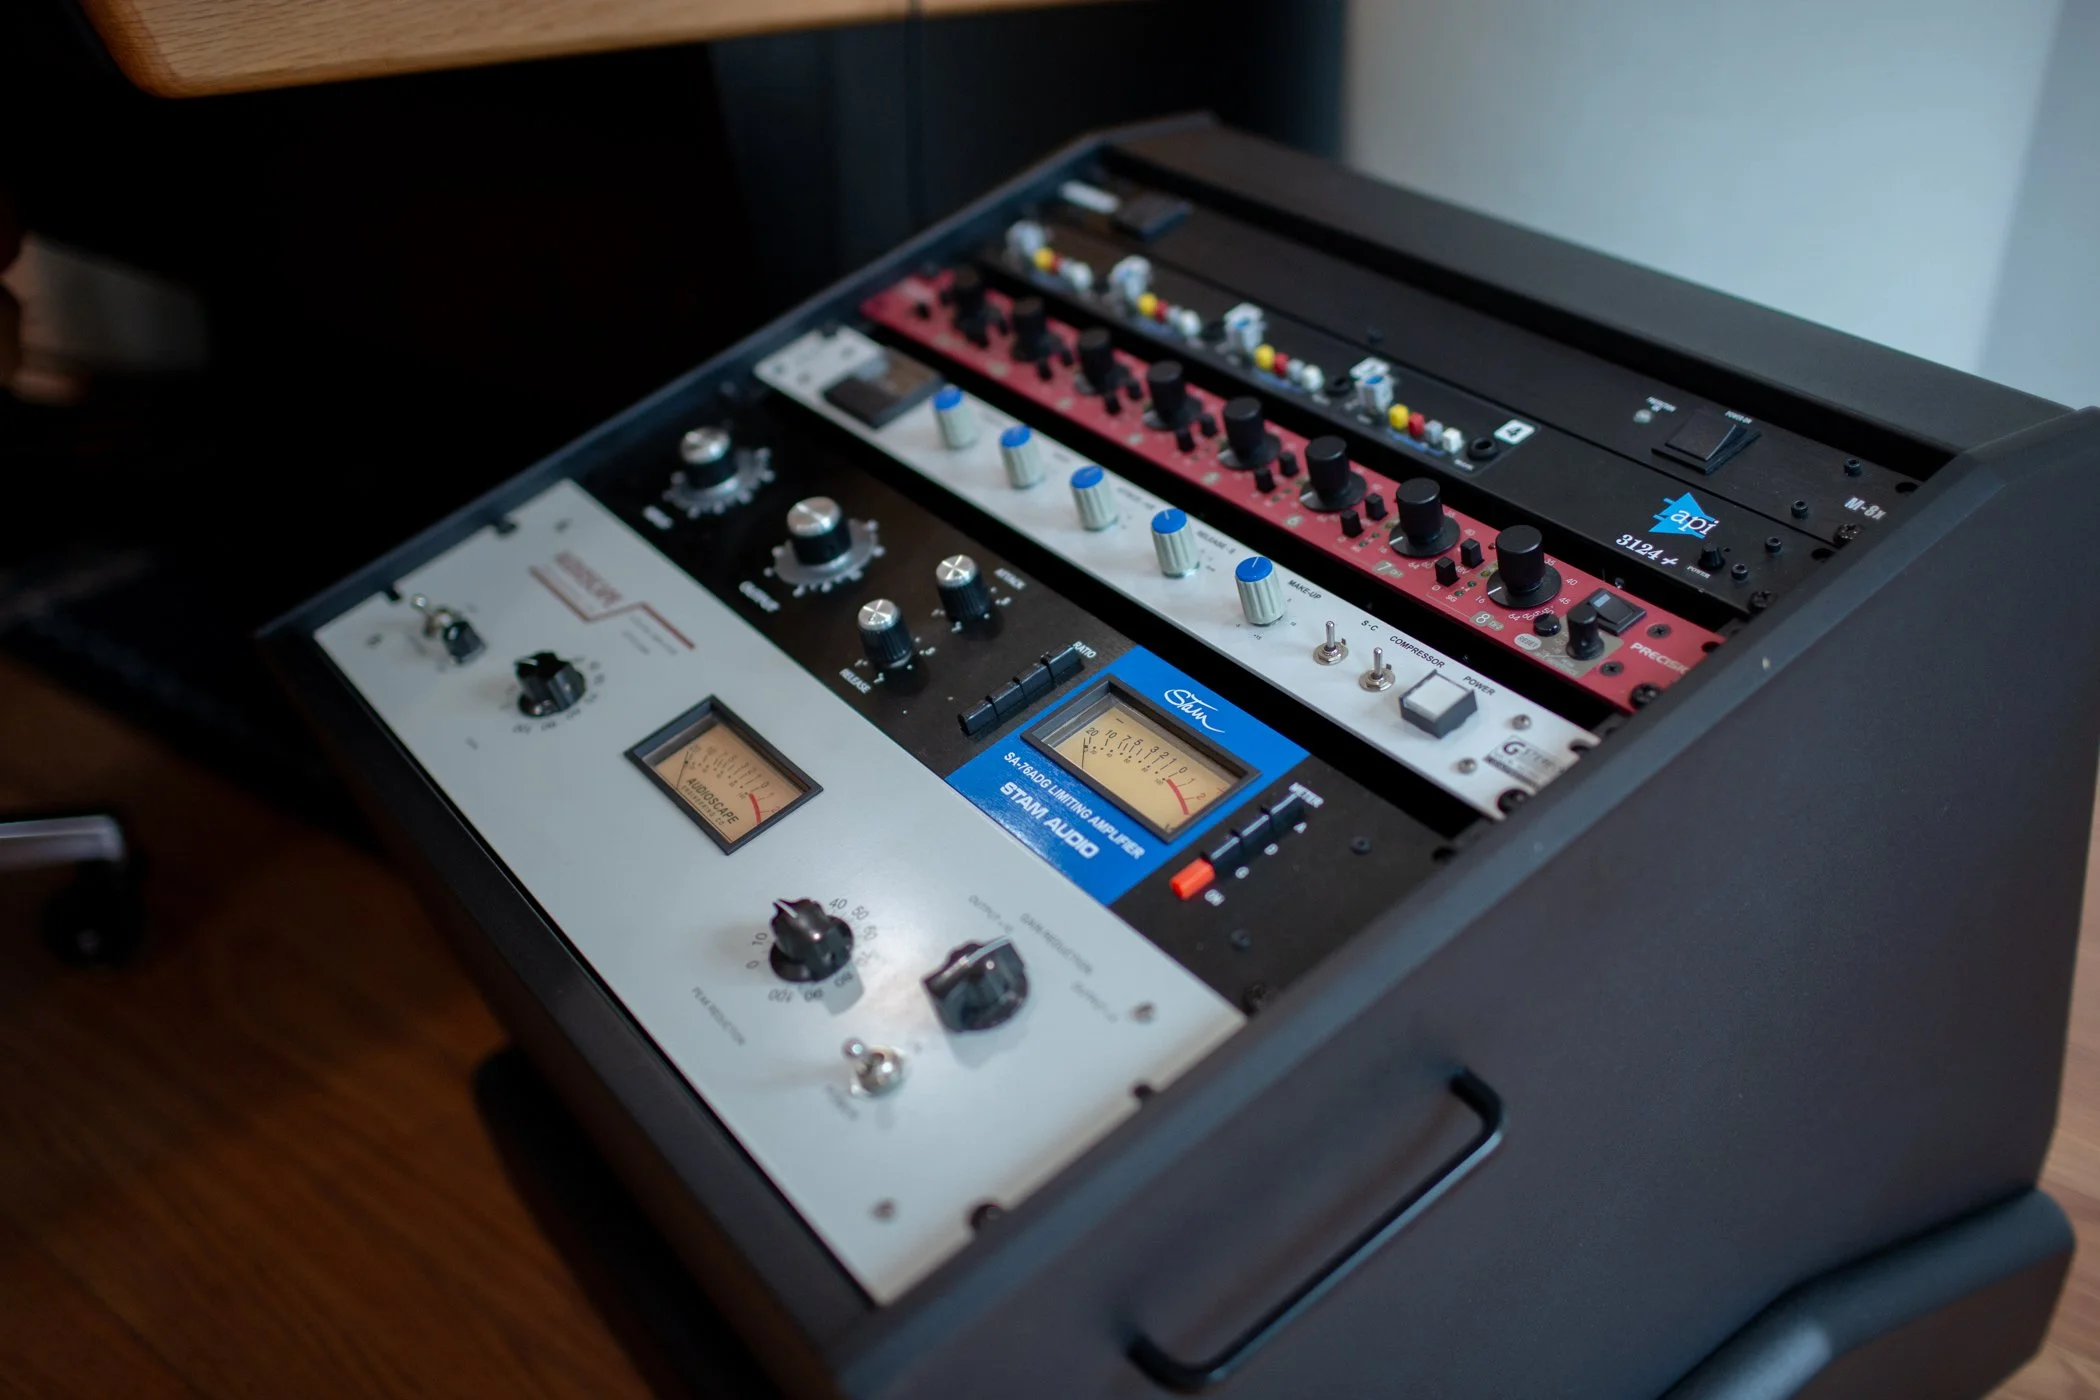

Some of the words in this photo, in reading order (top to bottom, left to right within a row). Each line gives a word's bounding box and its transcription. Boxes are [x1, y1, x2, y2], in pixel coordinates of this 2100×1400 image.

[1670, 510, 1720, 536] api
[1377, 562, 1392, 572] 7
[1686, 565, 1711, 579] POWER
[1287, 580, 1322, 600] MAKE-UP
[1565, 578, 1578, 586] 40
[1476, 613, 1490, 624] 8
[1073, 640, 1097, 659] RATIO
[1389, 635, 1445, 668] COMPRESSOR
[1517, 635, 1538, 649] RESET
[840, 668, 871, 694] RELEASE
[1462, 675, 1496, 696] POWER
[1086, 727, 1099, 737] 20
[1105, 729, 1118, 739] 10
[1150, 745, 1160, 753] 3
[1178, 766, 1188, 774] 0
[686, 777, 739, 824] AUDIOSCAPE
[1289, 782, 1324, 808] METER
[1004, 751, 1052, 788] SA-76ADG
[1048, 784, 1093, 819] LIMITING
[1087, 815, 1146, 860] AMPLIFIER
[1000, 781, 1049, 819] STAM
[1043, 817, 1100, 859] AUDIO
[829, 897, 848, 910] 40
[751, 932, 768, 946] 10
